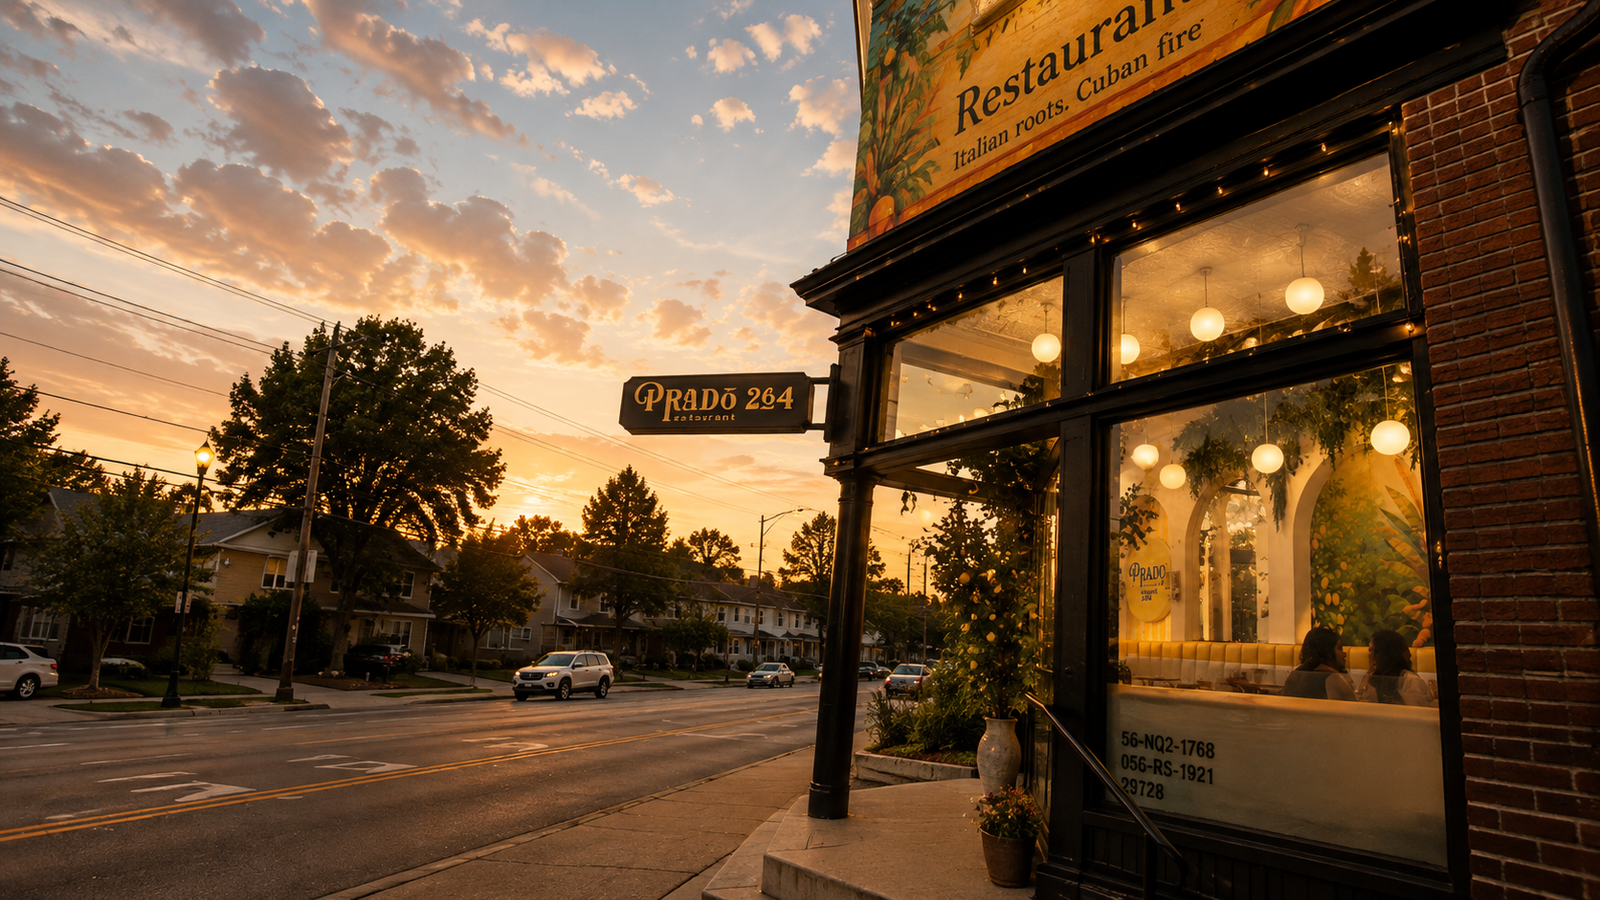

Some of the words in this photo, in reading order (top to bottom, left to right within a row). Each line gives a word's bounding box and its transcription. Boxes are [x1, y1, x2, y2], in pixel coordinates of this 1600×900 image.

[954, 0, 1190, 136] Restauran
[953, 129, 1010, 171] Italian
[1015, 98, 1070, 138] roots.
[1076, 54, 1149, 102] Cuban
[745, 386, 794, 410] 264
[1121, 731, 1215, 759] 56-NQ2-1768
[1121, 754, 1213, 785] 056-RS-1921
[1121, 777, 1165, 800] 29728
